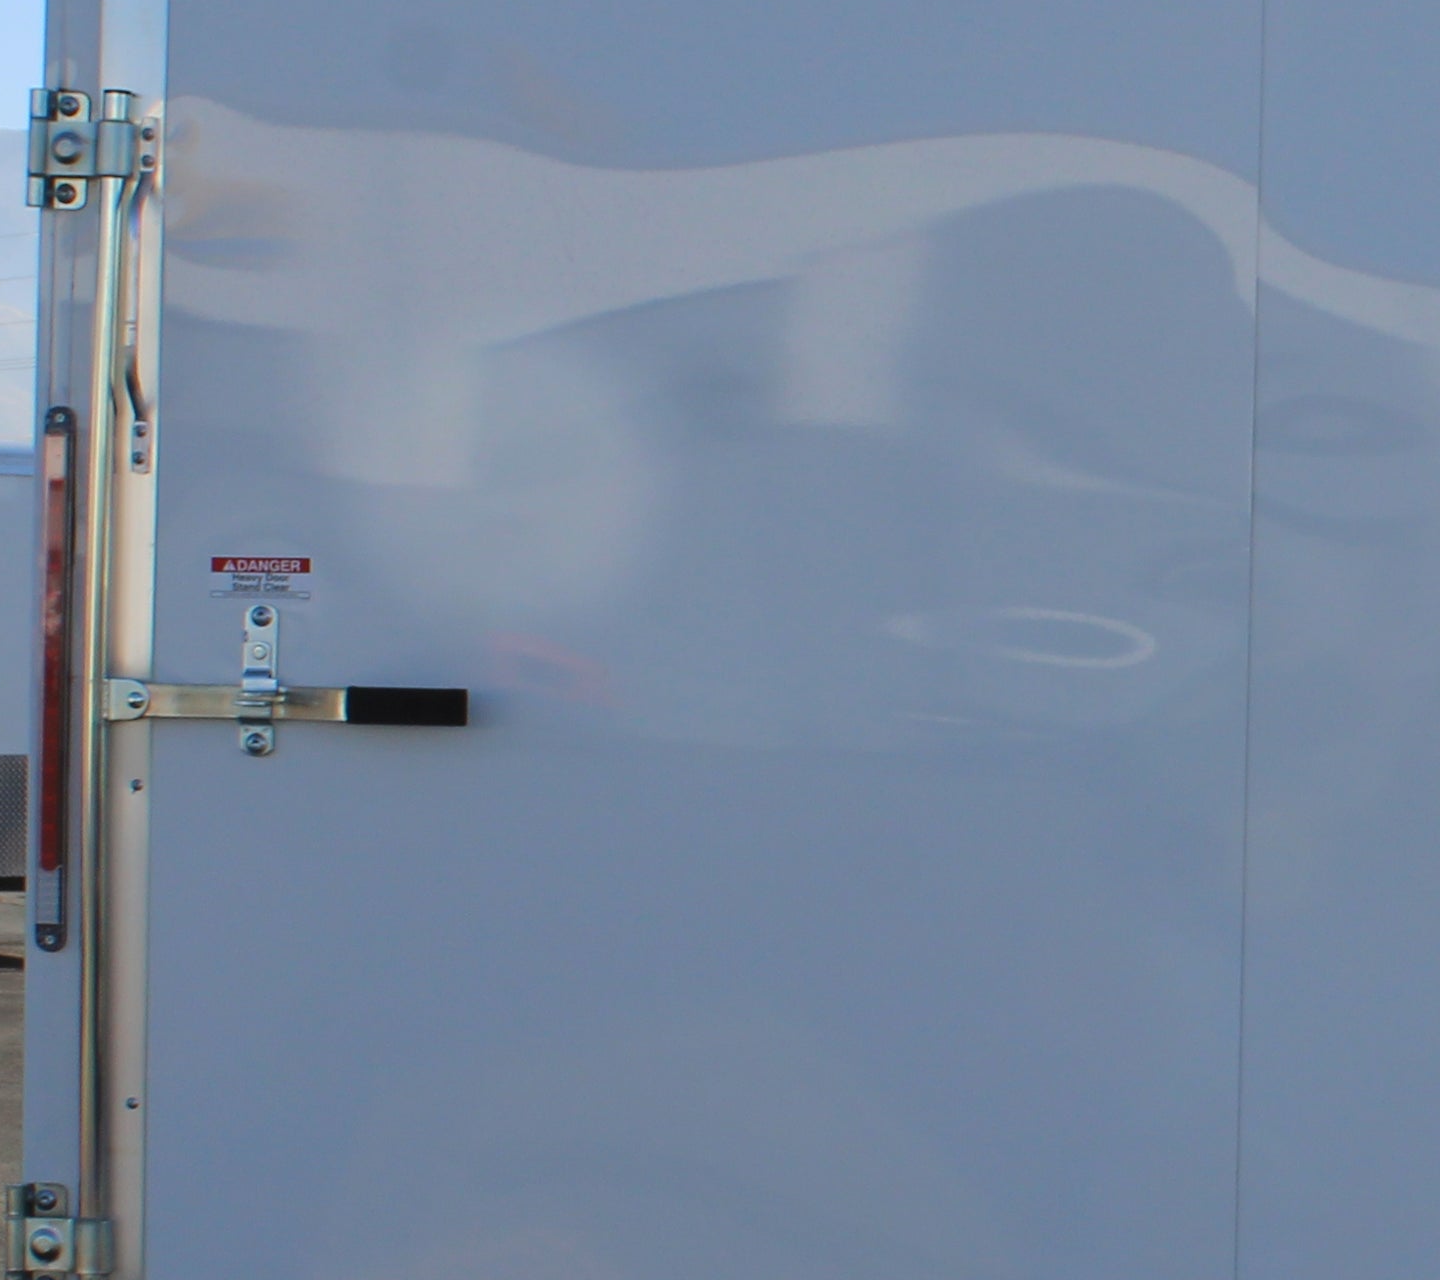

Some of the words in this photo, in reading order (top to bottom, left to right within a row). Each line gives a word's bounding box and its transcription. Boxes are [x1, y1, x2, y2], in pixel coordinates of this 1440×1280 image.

[237, 559, 301, 572] DANGER
[232, 573, 262, 583] Heavy
[265, 573, 289, 582] Door
[232, 583, 261, 592] Stand
[264, 583, 289, 592] Clear
